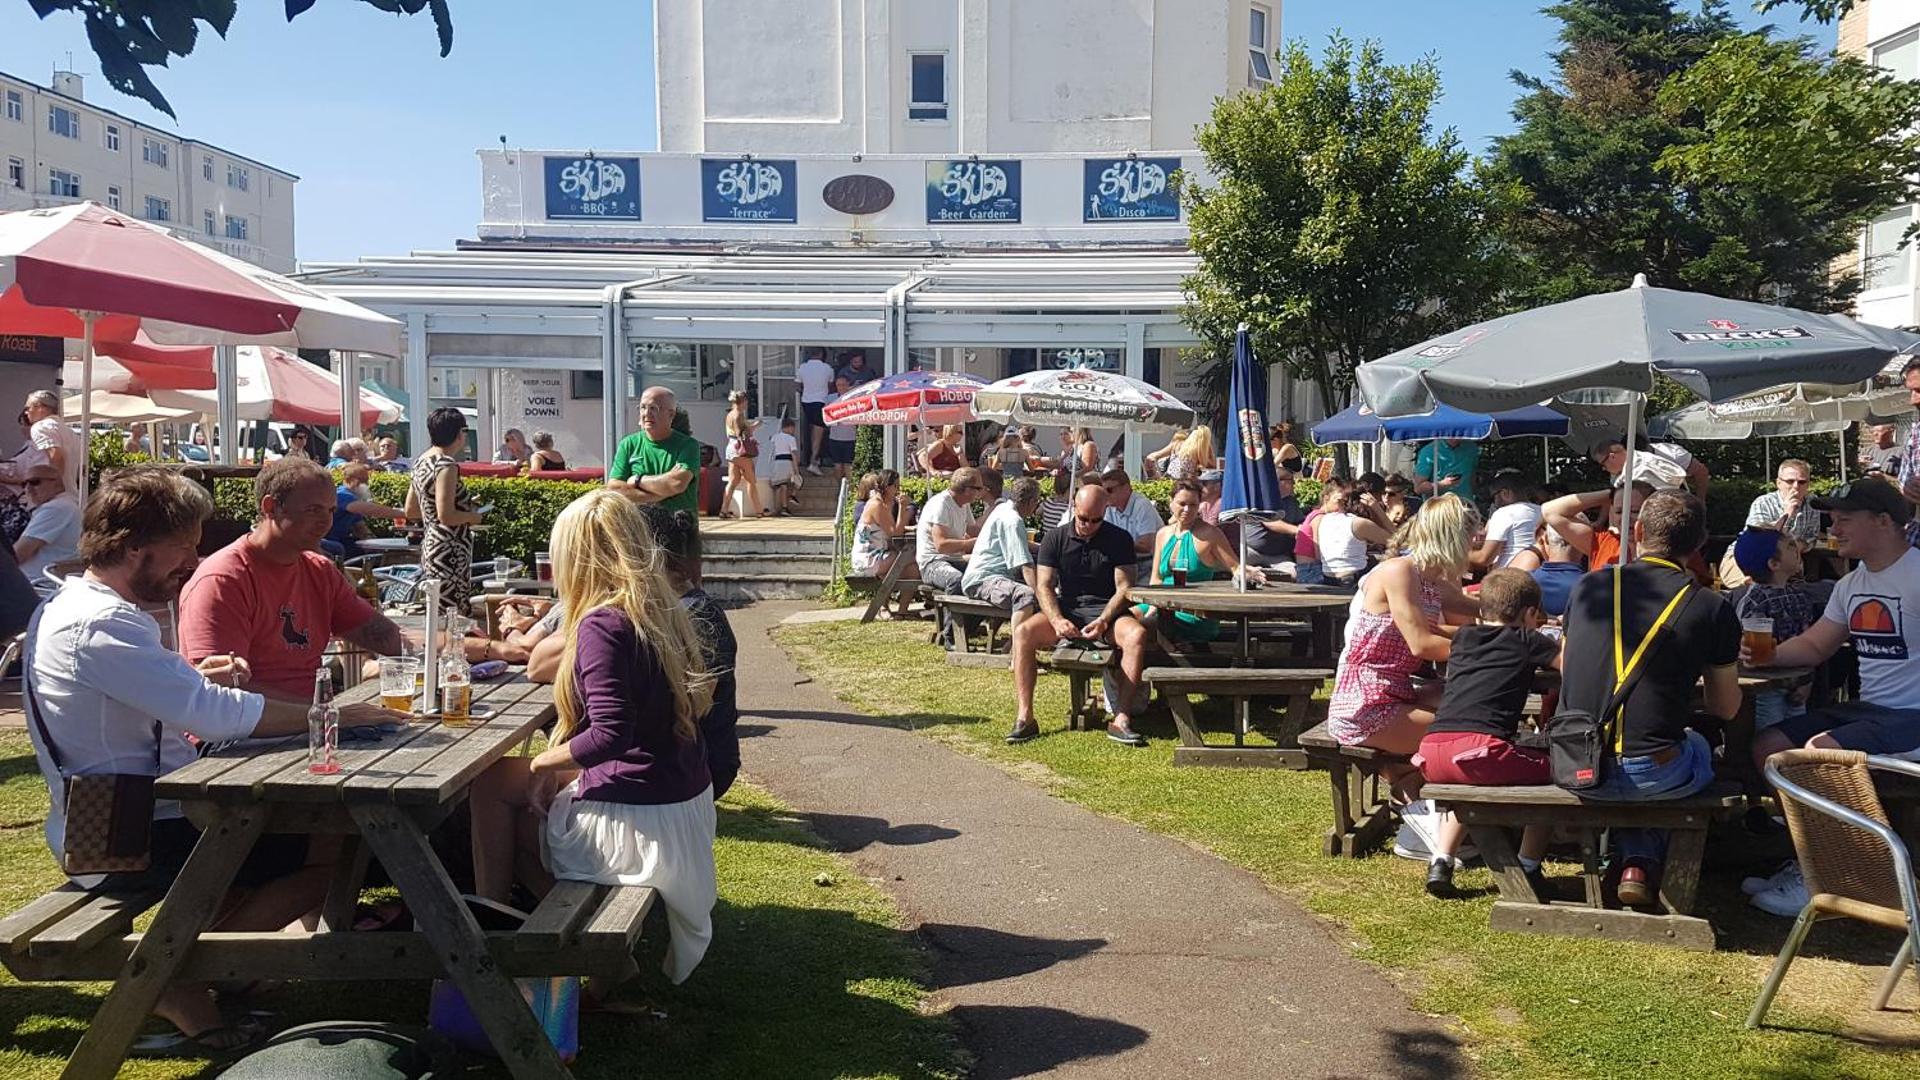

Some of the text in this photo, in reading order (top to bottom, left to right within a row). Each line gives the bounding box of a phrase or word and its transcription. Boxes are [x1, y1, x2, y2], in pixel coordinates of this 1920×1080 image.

[731, 207, 769, 218] Terrace
[941, 208, 1006, 219] Beer Garden
[1119, 206, 1146, 217] Disco
[527, 397, 556, 406] VOICE
[525, 407, 560, 416] DOWN!
